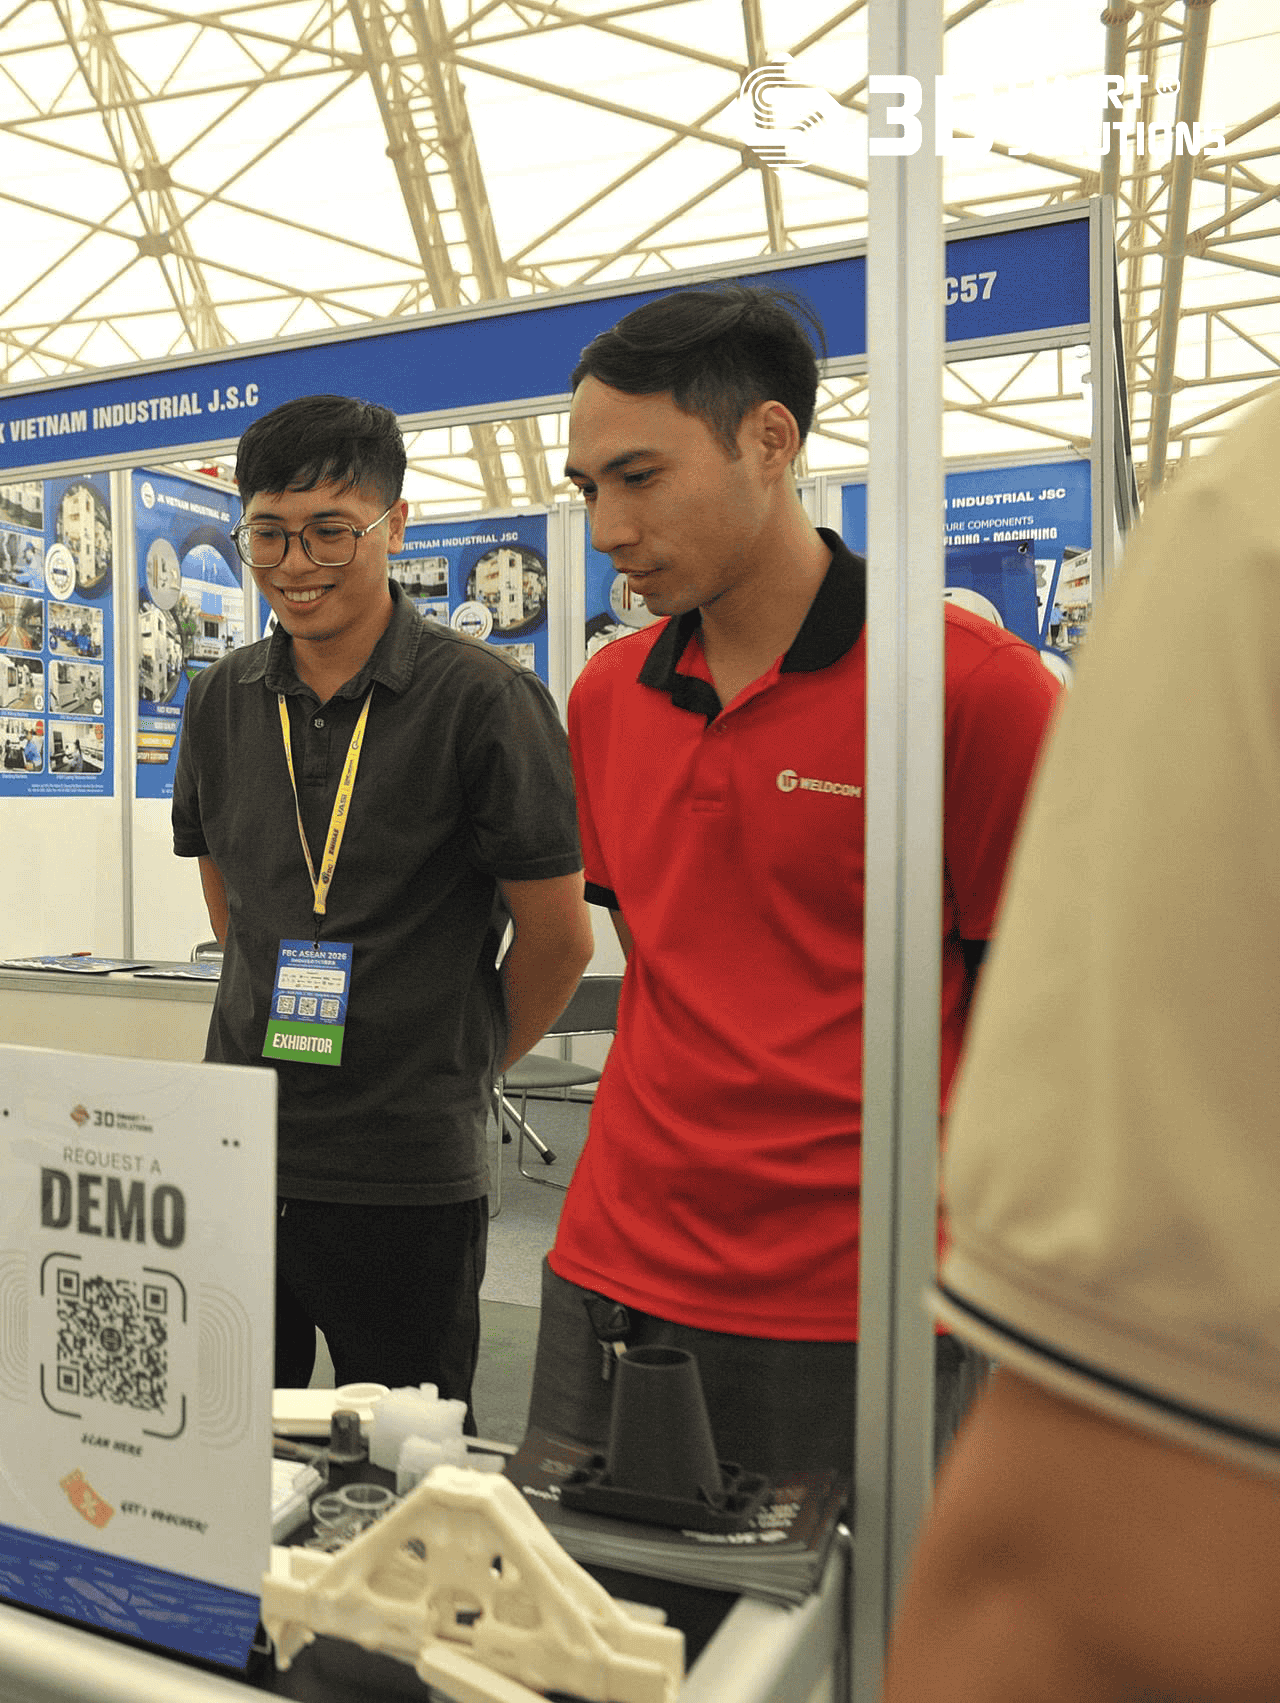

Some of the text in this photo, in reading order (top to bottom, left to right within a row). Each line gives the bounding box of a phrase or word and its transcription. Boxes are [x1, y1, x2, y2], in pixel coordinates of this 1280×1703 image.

[9, 409, 88, 443] VIETNAM
[93, 392, 202, 430] INDUSTRIAL
[208, 383, 260, 413] J.S.C
[952, 491, 1034, 509] INDUSTRIAL
[1038, 488, 1066, 500] JSC
[967, 515, 1034, 530] COMPONENTS
[442, 534, 497, 547] INDUSTRIAL
[500, 531, 518, 542] JSC
[799, 776, 862, 798] WELDCOM
[282, 948, 348, 961] FBC ASEAN 2026
[272, 1032, 333, 1054] EXHIBITOR
[93, 1109, 115, 1127] 3D
[63, 1146, 162, 1175] REQUEST A
[41, 1165, 187, 1250] DEMO
